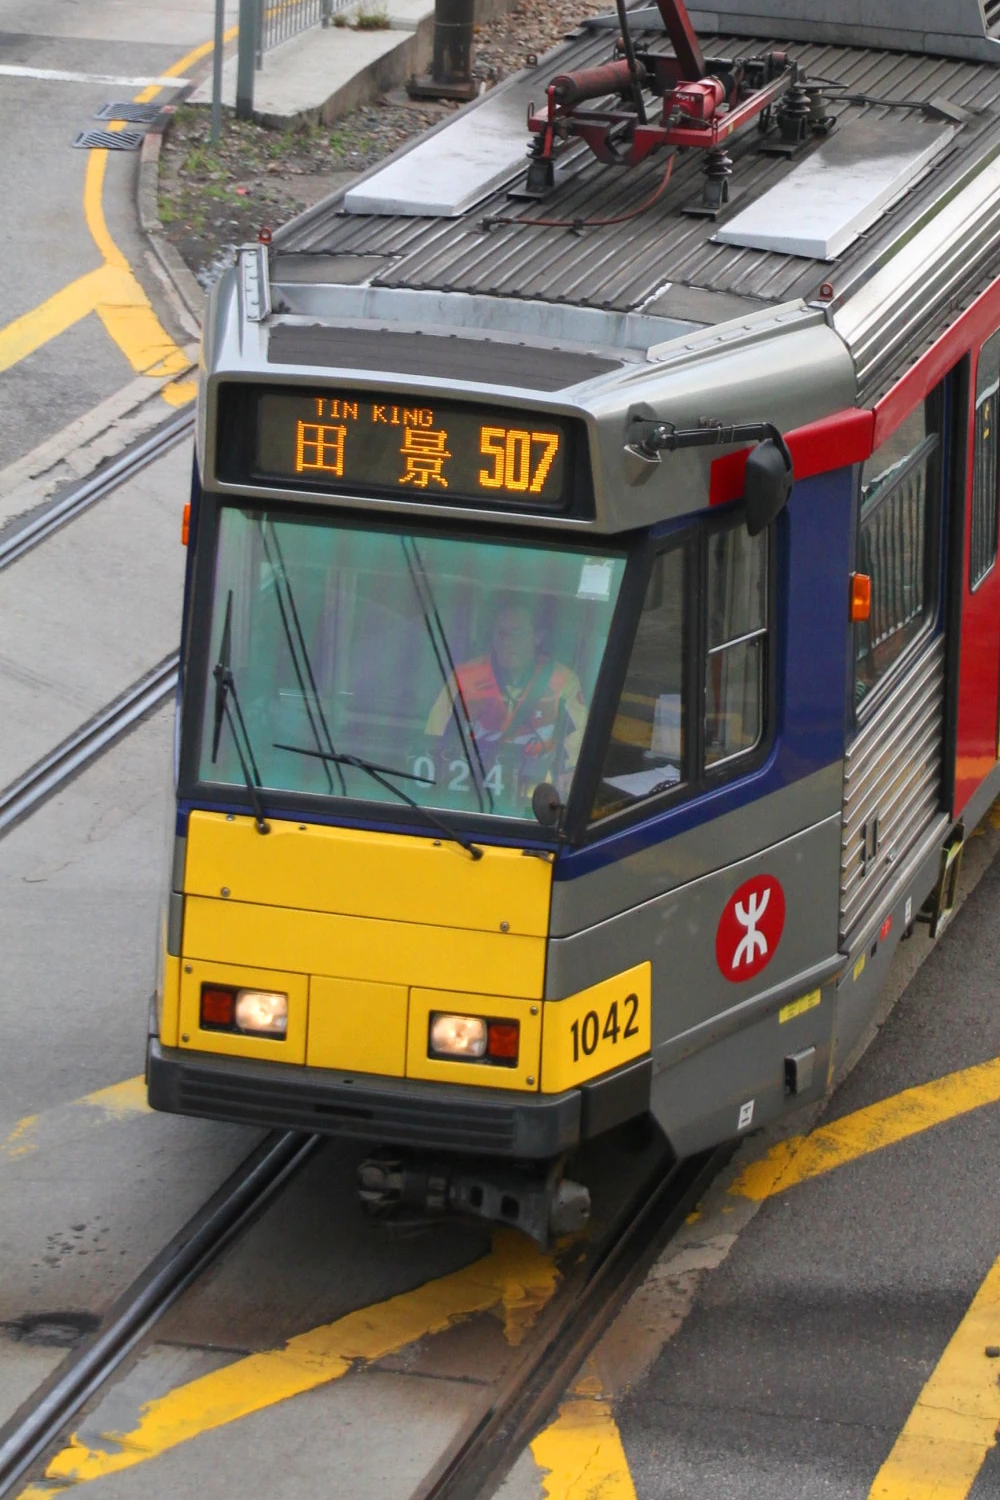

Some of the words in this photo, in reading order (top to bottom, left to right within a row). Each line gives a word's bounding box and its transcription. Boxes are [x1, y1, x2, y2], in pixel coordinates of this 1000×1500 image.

[314, 398, 358, 420] TIN
[372, 404, 434, 427] KING
[479, 426, 560, 492] 507
[570, 992, 640, 1062] 1042
